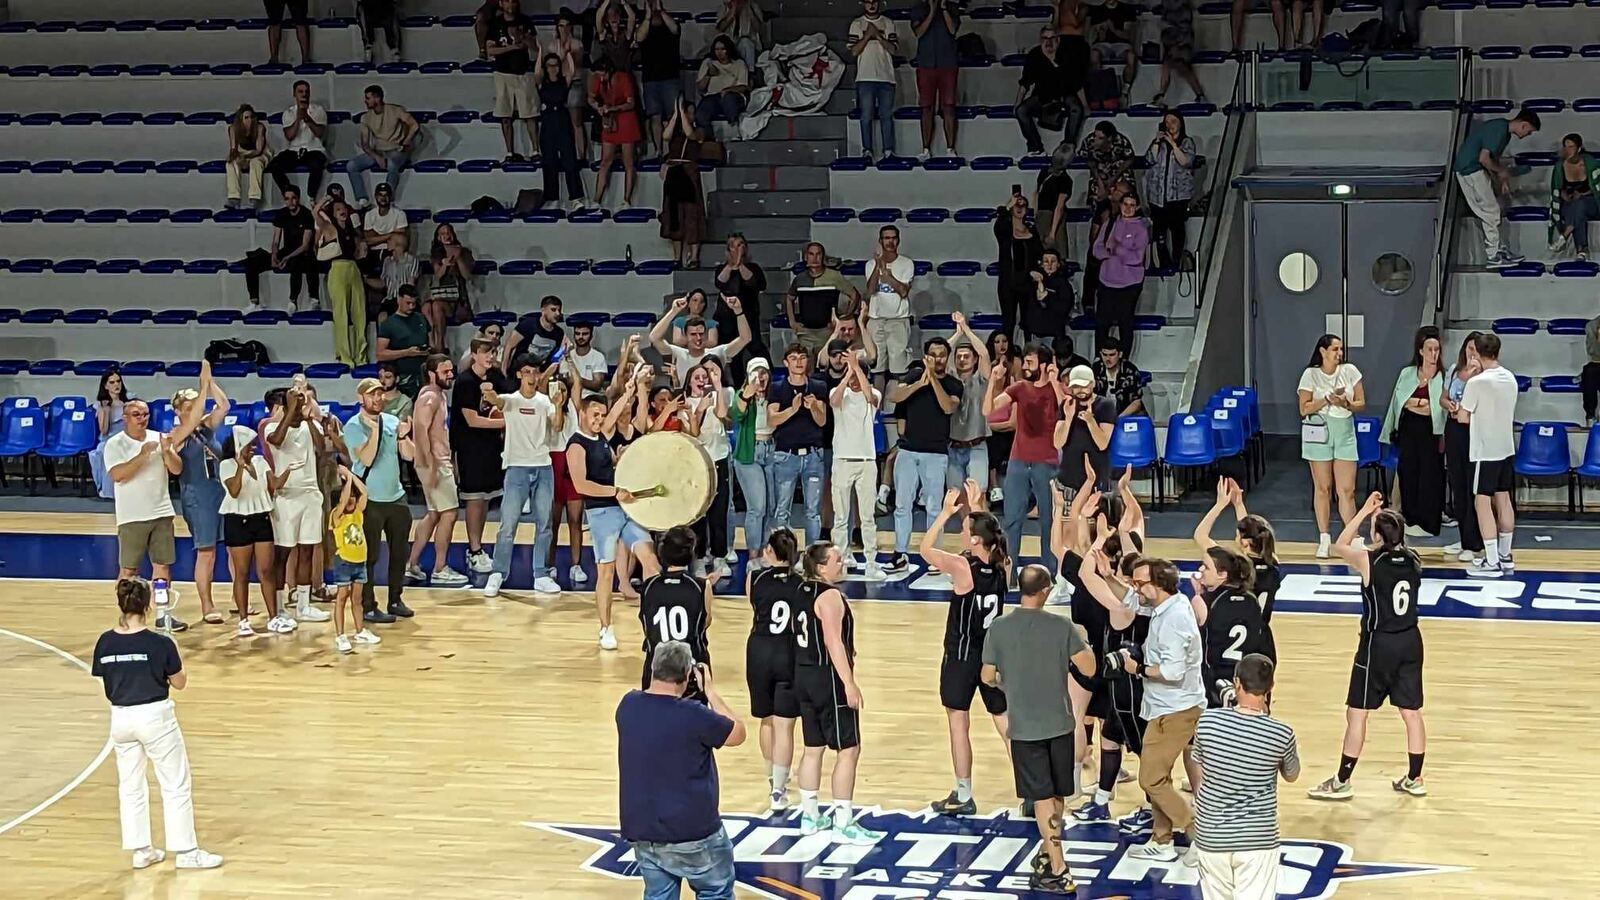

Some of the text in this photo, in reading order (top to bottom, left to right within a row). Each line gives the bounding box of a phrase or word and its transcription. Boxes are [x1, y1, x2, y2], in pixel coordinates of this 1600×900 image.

[1392, 580, 1410, 616] 6
[653, 606, 688, 641] 10
[770, 601, 790, 634] 9
[1222, 624, 1248, 660] 2
[804, 864, 1092, 890] BASKE
